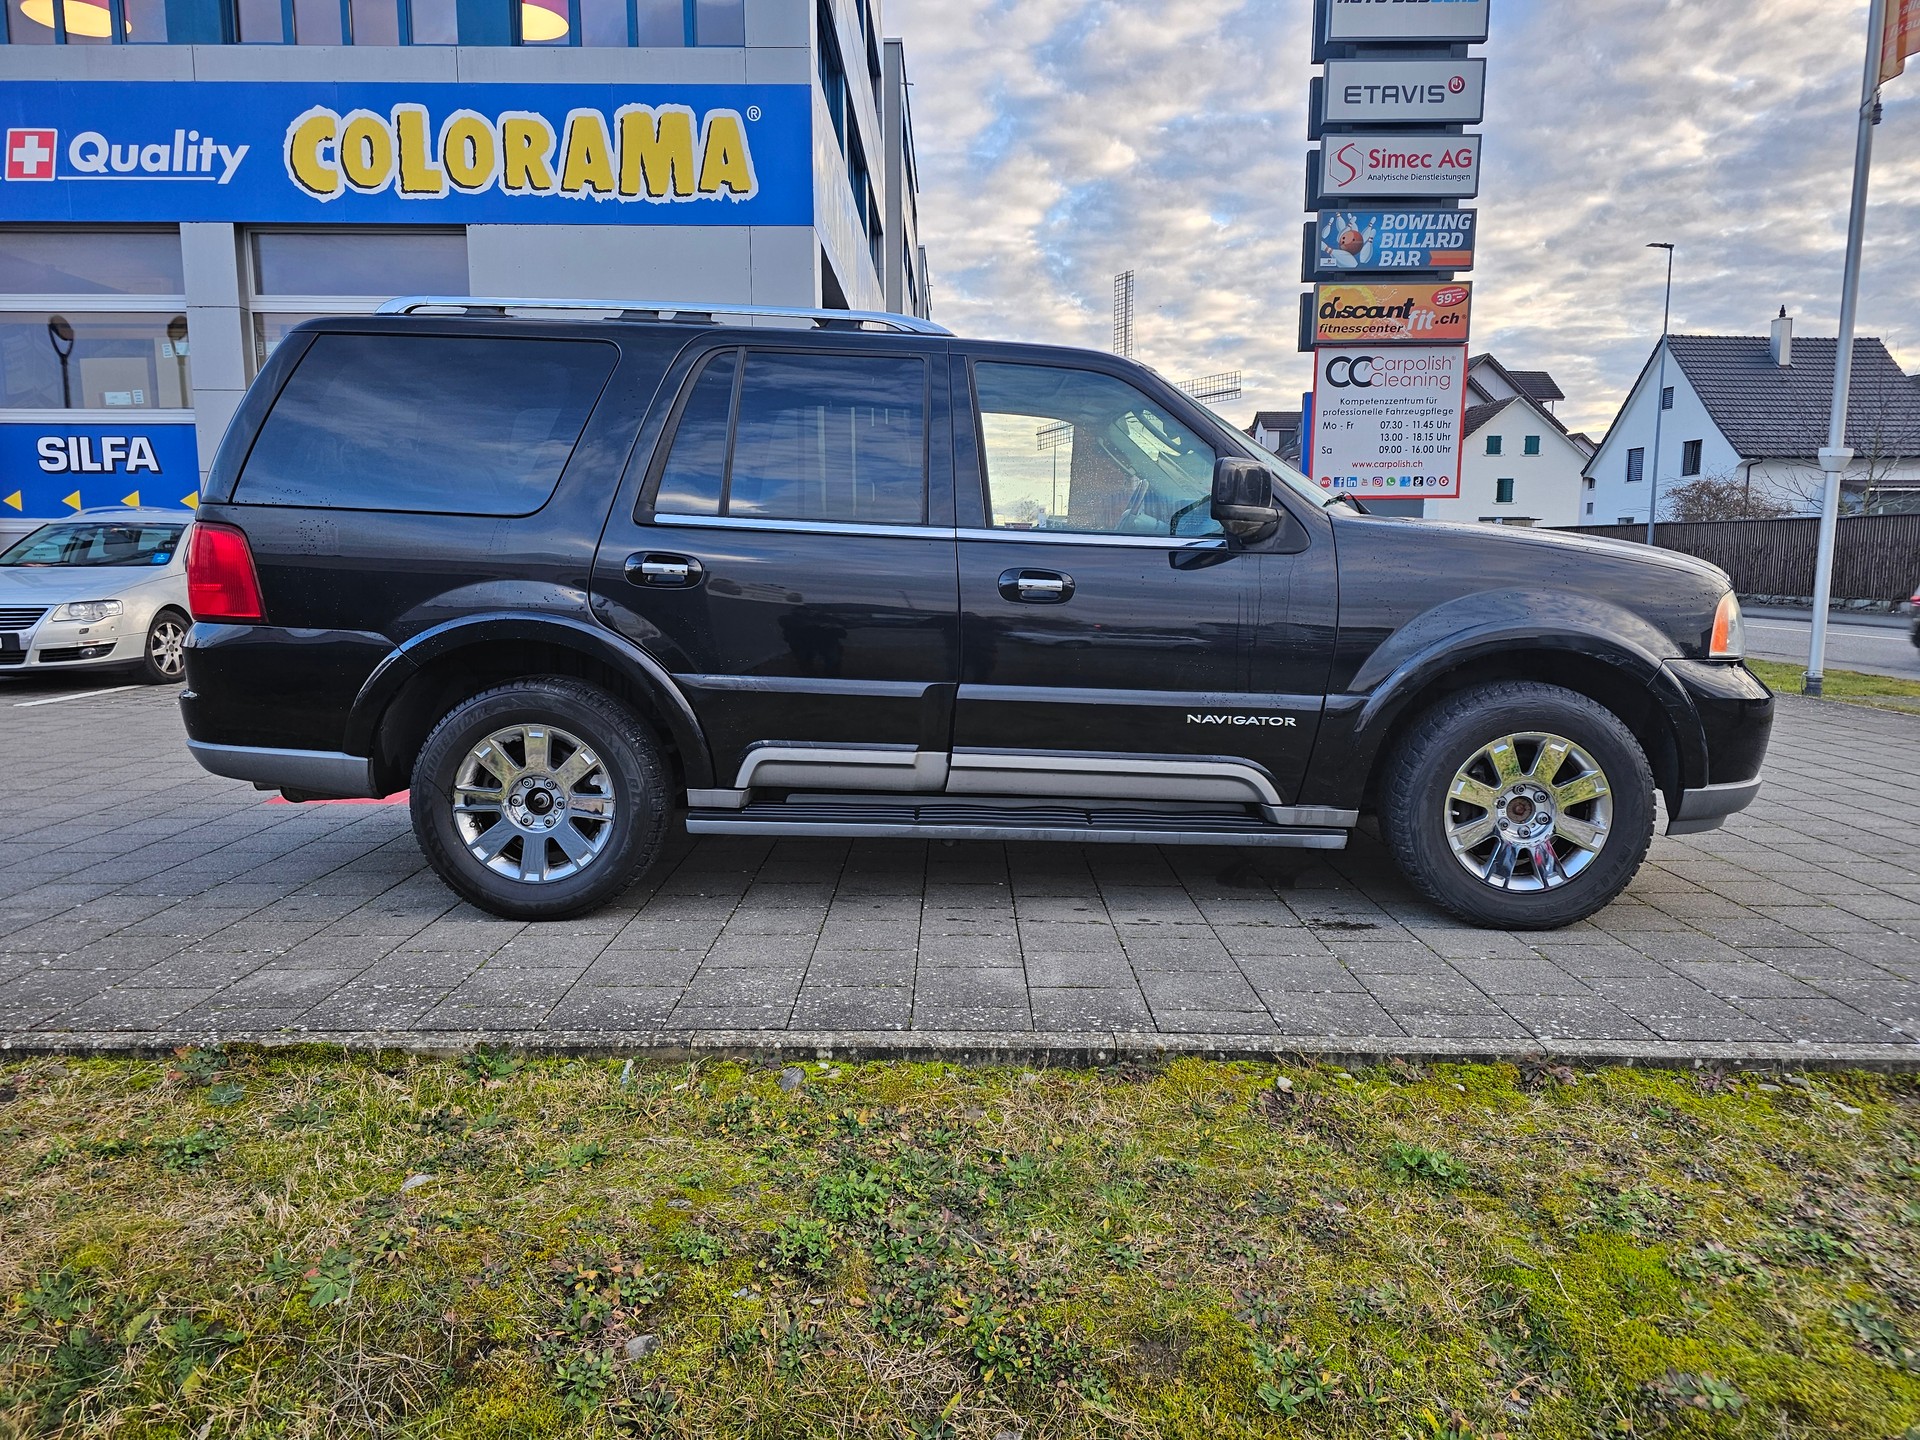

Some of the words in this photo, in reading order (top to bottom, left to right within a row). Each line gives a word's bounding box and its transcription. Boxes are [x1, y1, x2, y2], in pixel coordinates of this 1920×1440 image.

[1344, 85, 1446, 104] ETAVIS
[68, 129, 250, 184] Quality
[285, 105, 756, 201] COLORAMA
[1368, 148, 1433, 169] Simec
[1438, 148, 1473, 168] AG
[1367, 173, 1409, 182] Analytische
[1410, 173, 1471, 182] Dienstleistungen
[1380, 214, 1473, 230] BOWLING
[1379, 232, 1464, 249] BILLARD
[1378, 250, 1422, 267] BAR
[1319, 323, 1404, 334] fitnesscenter
[1370, 355, 1451, 374] Carpolish
[1370, 372, 1451, 390] Cleaning
[1340, 398, 1424, 407] Kompetenzzentrum
[1426, 397, 1438, 405] für
[1322, 408, 1384, 417] professionelle
[1385, 407, 1454, 417] Fahrzeugpflege
[1322, 421, 1337, 430] Mo
[1346, 421, 1355, 430] Fr
[1379, 420, 1403, 430] 07.30
[1412, 420, 1434, 429] 11.45
[1436, 420, 1452, 429] Uhr
[1380, 432, 1403, 442] 13.00
[1412, 432, 1434, 442] 18.15
[1436, 432, 1451, 441] Uhr
[36, 436, 161, 474] SILFA
[1321, 446, 1333, 455] Sa
[1378, 445, 1402, 454] 09.00
[1411, 445, 1434, 454] 16.00
[1436, 445, 1451, 453] Uhr
[1351, 460, 1423, 470] www.carpolish.ch
[1186, 714, 1297, 727] NAVIGATOR
